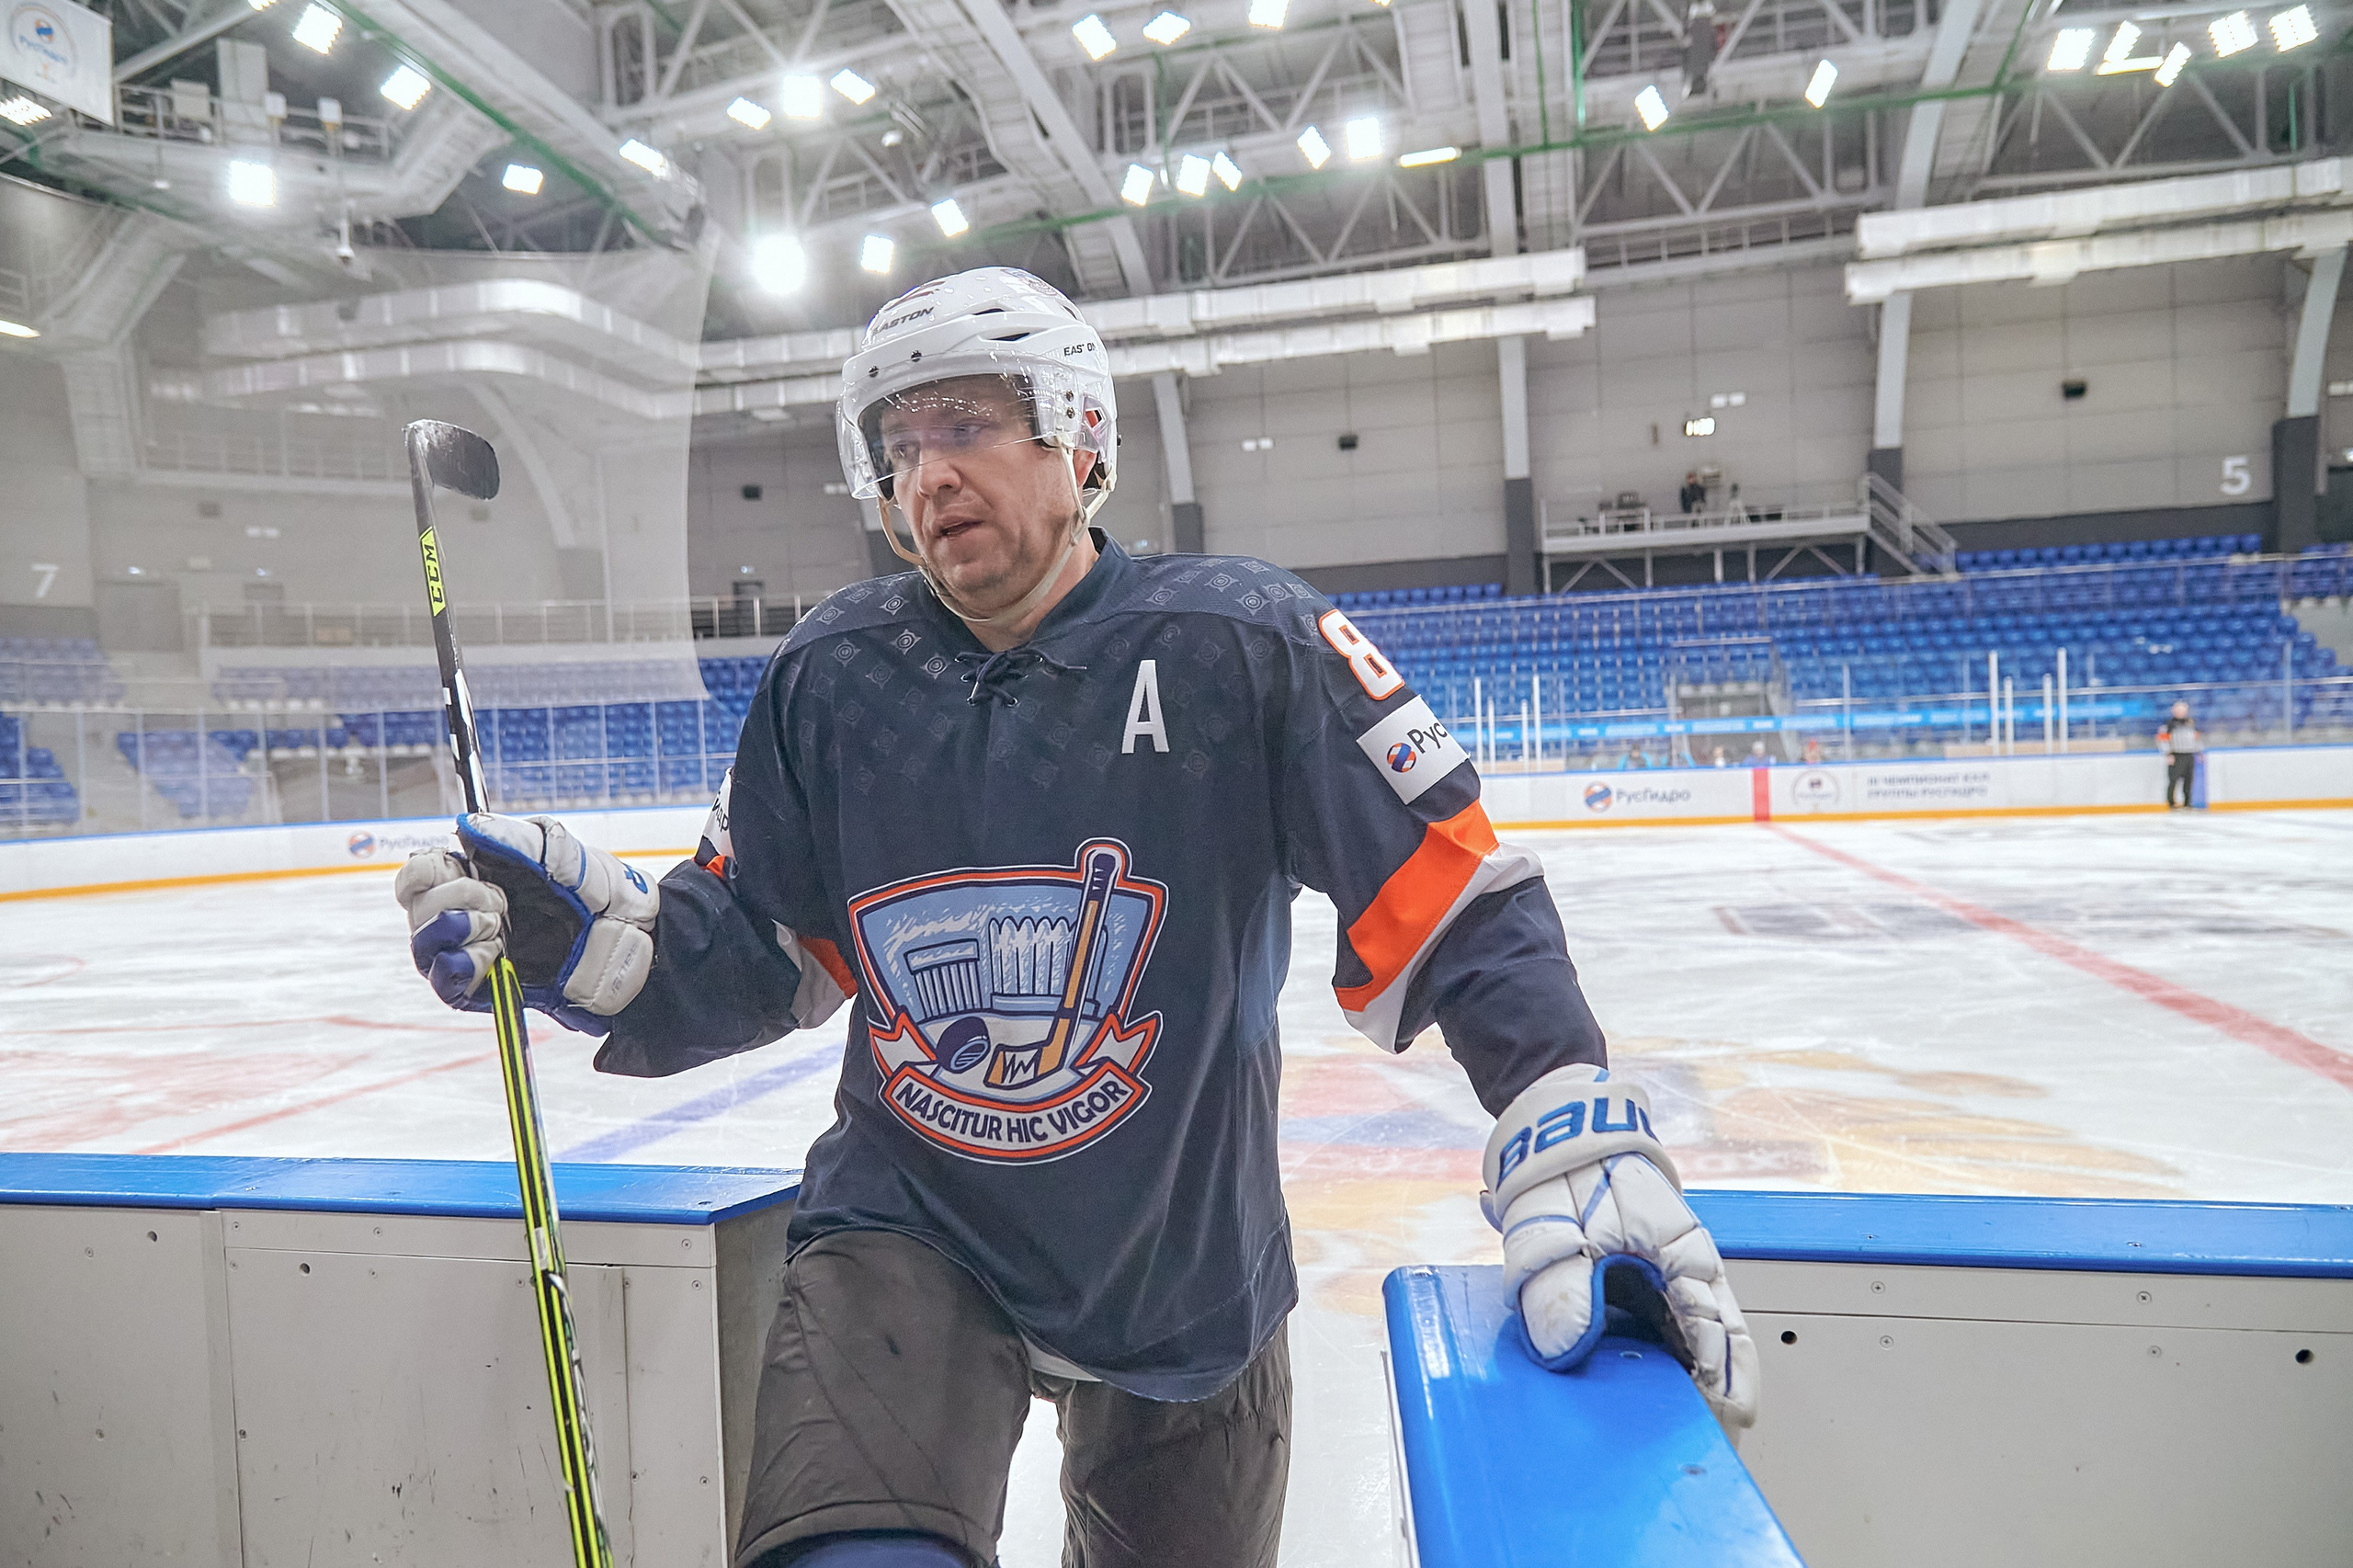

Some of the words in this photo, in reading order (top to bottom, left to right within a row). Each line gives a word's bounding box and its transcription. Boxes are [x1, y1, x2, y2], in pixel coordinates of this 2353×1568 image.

[2221, 456, 2251, 496] 5
[31, 562, 58, 597] 7
[424, 544, 443, 603] CCM
[1318, 608, 1405, 701] 8
[1121, 659, 1169, 754] A
[1615, 787, 1692, 804] РусГидро
[894, 1082, 1002, 1142] NASCITUR
[1006, 1116, 1049, 1143] HIC
[1046, 1080, 1129, 1136] VIGOR
